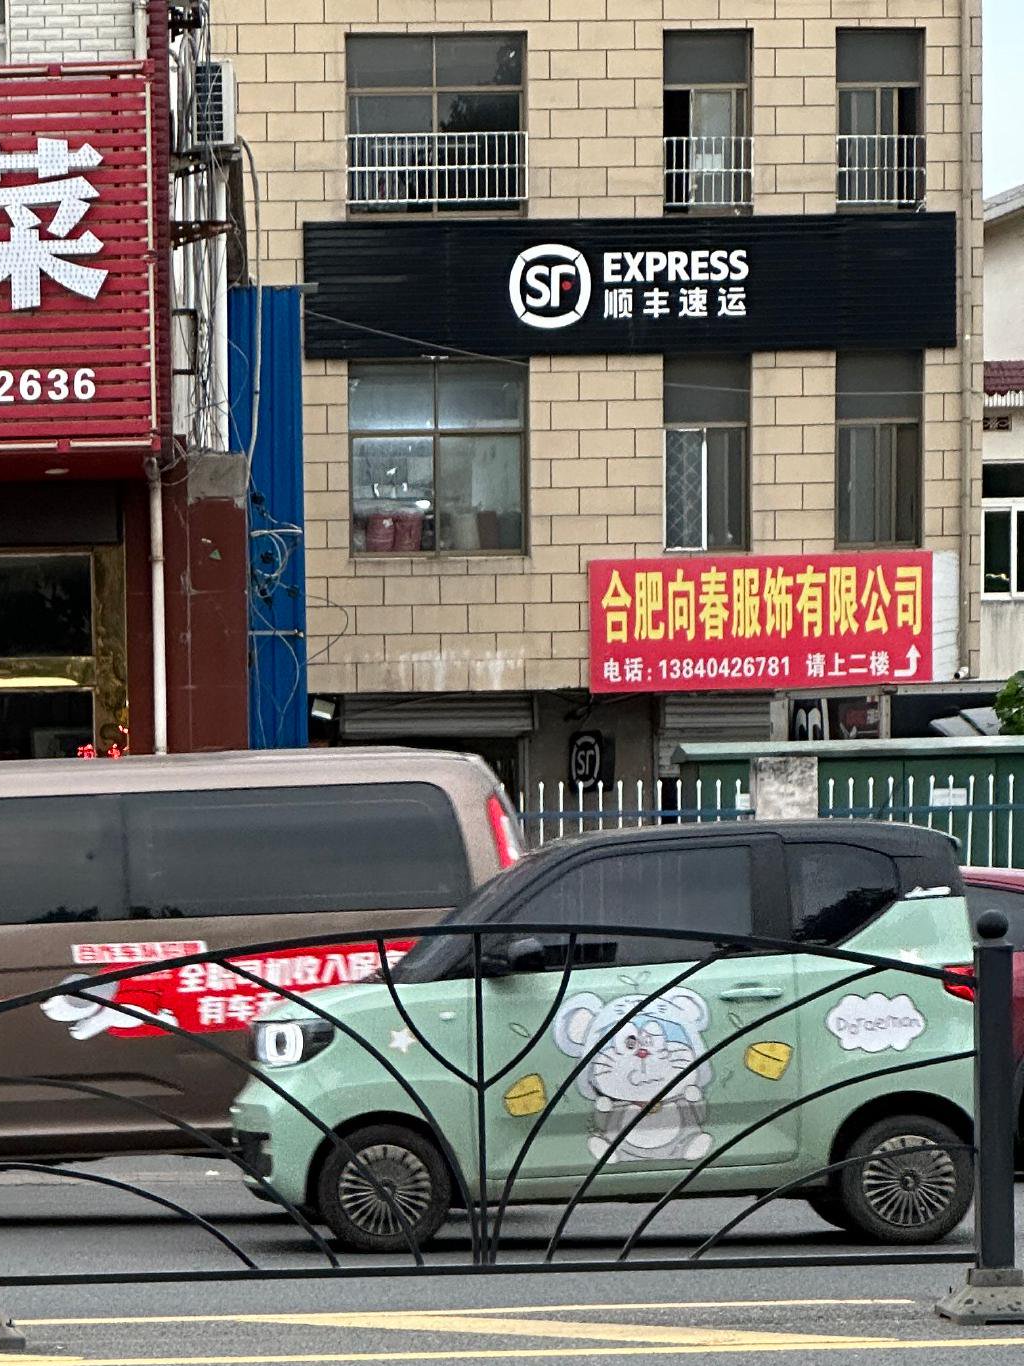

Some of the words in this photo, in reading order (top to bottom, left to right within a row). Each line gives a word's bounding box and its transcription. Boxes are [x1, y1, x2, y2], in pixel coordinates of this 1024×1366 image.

[603, 249, 750, 282] EXPRESS
[603, 286, 747, 320] 顺丰速运
[600, 564, 923, 644] 合肥向春服饰有限公司
[806, 650, 890, 677] 请上二楼
